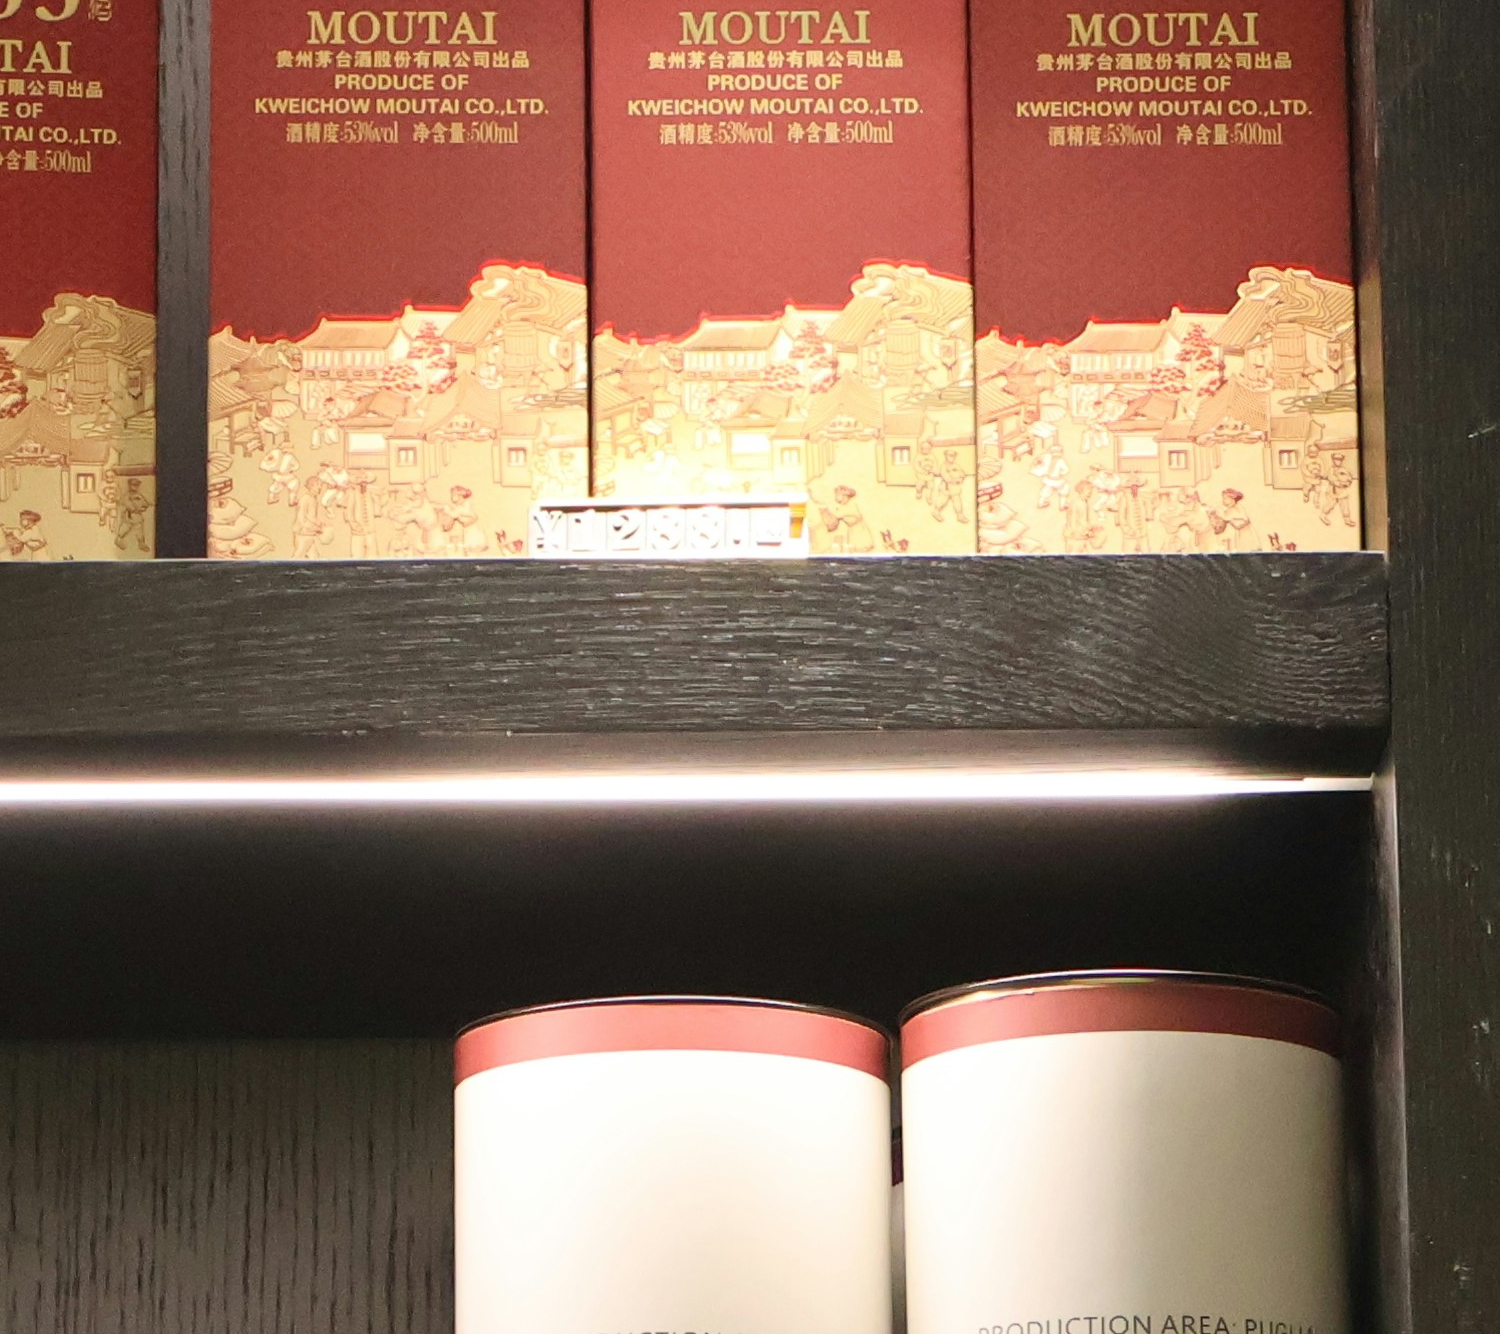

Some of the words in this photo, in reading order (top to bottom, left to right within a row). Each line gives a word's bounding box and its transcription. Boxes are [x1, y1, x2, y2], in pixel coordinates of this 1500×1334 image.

[307, 11, 498, 45] MOUTAI
[679, 10, 870, 45] MOUTAI
[1067, 12, 1259, 47] MOUTAI
[275, 50, 530, 69] 贵州茅台酒股份有限公司出品
[648, 50, 903, 69] 贵州茅台酒股份有限公司出品
[1036, 52, 1292, 71] 贵州茅台酒股份有限公司出品
[335, 74, 434, 91] PRODUCE
[441, 74, 469, 90] OF
[708, 74, 808, 91] PRODUCE
[815, 74, 843, 90] OF
[1097, 76, 1196, 93] PRODUCE
[1204, 76, 1231, 92] OF
[16, 102, 44, 118] OF
[255, 98, 370, 114] KWEICHOW
[376, 98, 459, 114] MOUTAI
[465, 98, 549, 117] CO.,LTD.
[628, 99, 743, 115] KWEICHOW
[750, 99, 833, 115] MOUTAI
[839, 98, 924, 117] CO.,LTD.
[1017, 101, 1132, 117] KWEICHOW
[1139, 101, 1222, 116] MOUTAI
[1228, 99, 1312, 118] CO.,LTD.
[39, 127, 120, 144] CO.,LTD.
